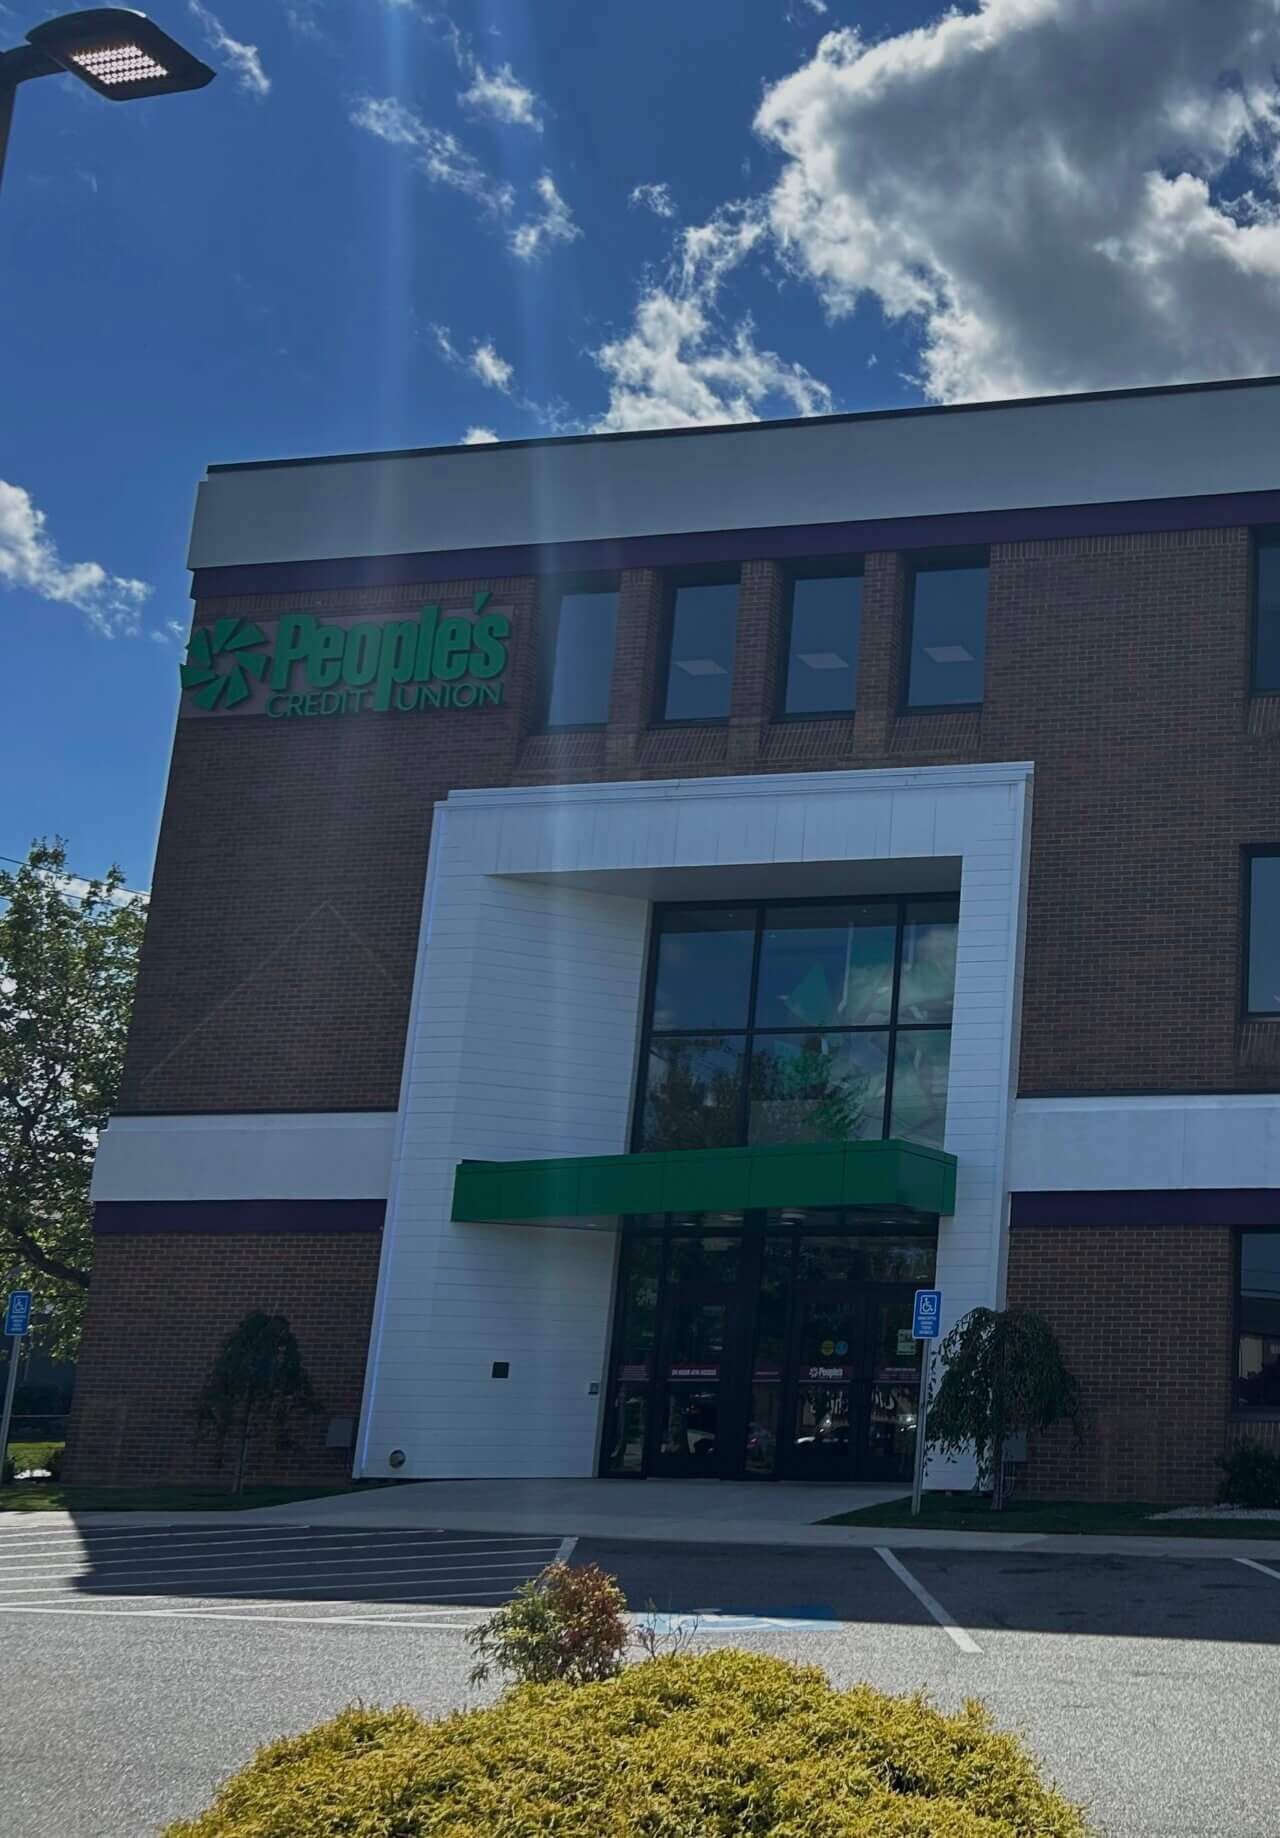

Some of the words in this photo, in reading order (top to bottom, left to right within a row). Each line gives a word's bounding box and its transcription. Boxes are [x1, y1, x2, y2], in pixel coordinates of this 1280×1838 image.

[271, 592, 510, 711] People's
[267, 690, 367, 717] CREDIT
[398, 684, 503, 710] UNION
